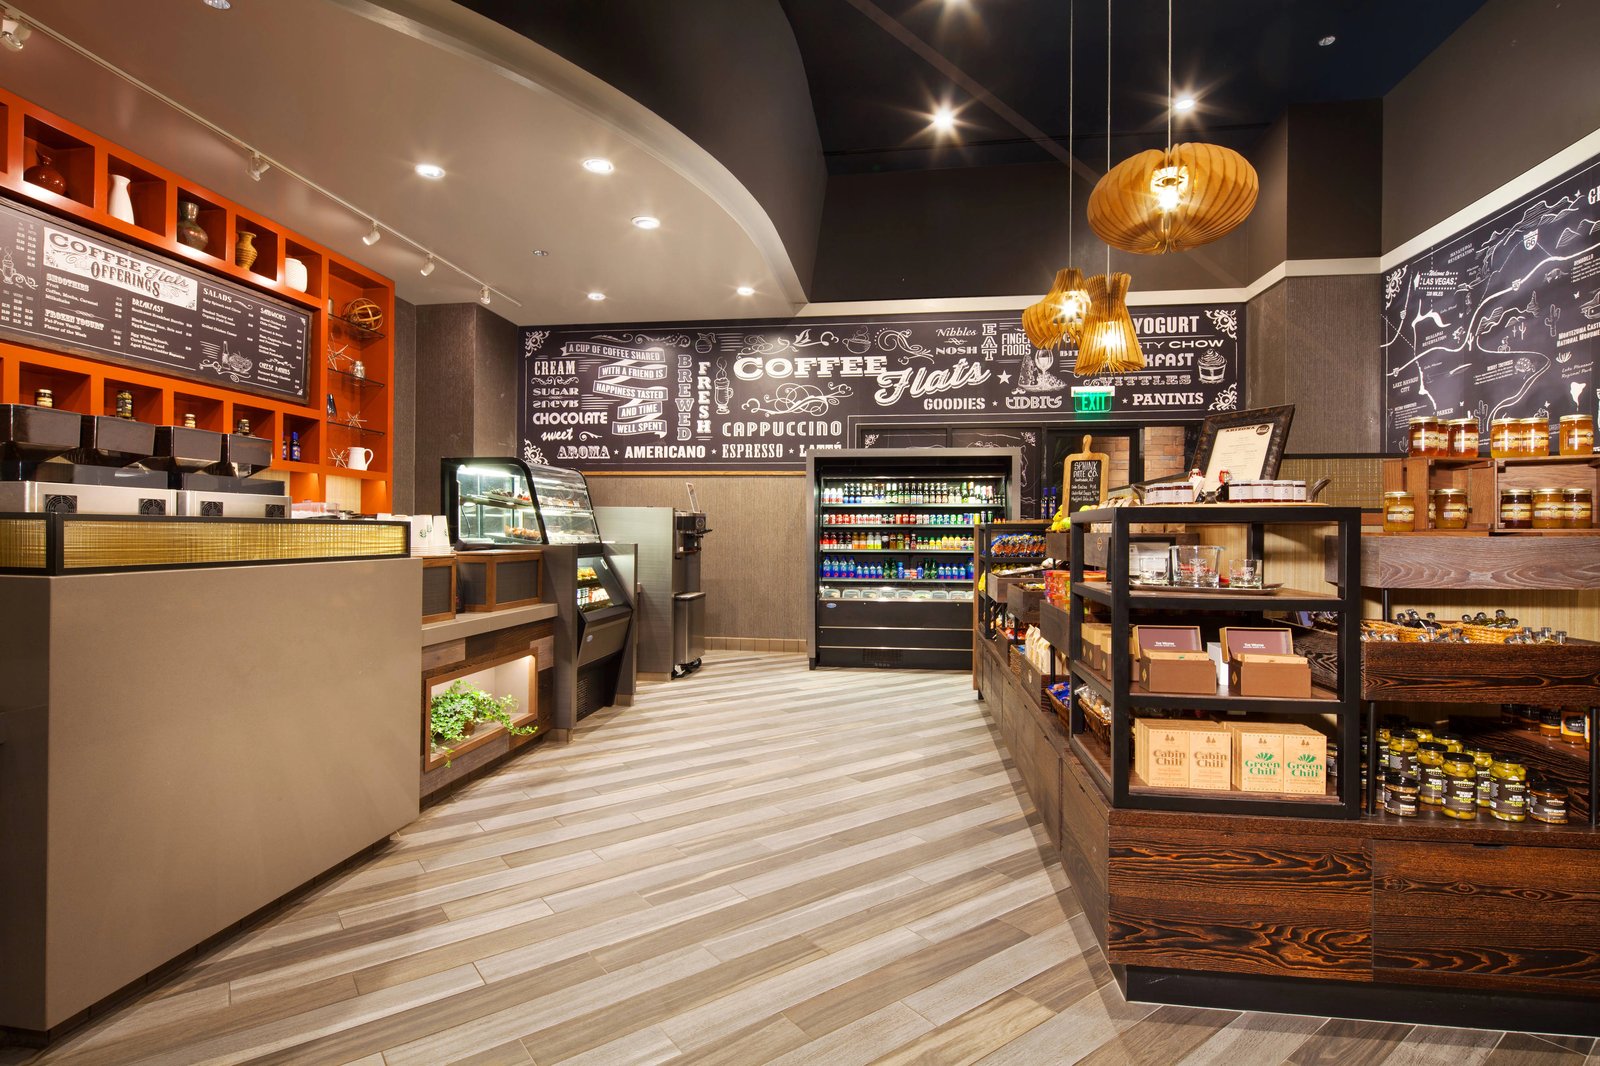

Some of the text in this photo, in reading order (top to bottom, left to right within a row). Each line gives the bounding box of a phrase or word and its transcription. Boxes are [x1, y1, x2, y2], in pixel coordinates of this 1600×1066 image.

[50, 233, 140, 272] COFFEE
[90, 261, 161, 298] OFFERINGS
[1422, 278, 1454, 286] LAS VEGAS
[203, 288, 232, 303] SALADS
[1133, 316, 1200, 334] YOGURT
[936, 327, 977, 337] Nibbles
[981, 323, 998, 361] EAT
[1169, 340, 1224, 348] CHOW
[575, 345, 590, 353] CUP
[592, 345, 600, 353] OF
[602, 347, 629, 359] COFFEE
[631, 351, 660, 361] SHARED
[936, 346, 978, 355] NOSH
[1002, 344, 1031, 356] FOODS
[534, 360, 576, 375] CREAM
[602, 367, 621, 375] WITH
[628, 368, 654, 378] FRIEND
[655, 369, 663, 377] IS
[733, 355, 992, 406] COFFEE Flats
[1100, 375, 1191, 386] VITTLES
[533, 388, 579, 396] SUGAR
[596, 382, 664, 399] HAPPINESS TASTED
[675, 354, 694, 441] BREWED
[697, 362, 712, 434] FRESH
[924, 398, 986, 410] GOODIES
[1132, 392, 1204, 406] PANINIS
[1082, 395, 1106, 410] EXIT
[621, 404, 658, 417] AND TIME
[532, 412, 608, 425] CHOCOLATE
[541, 427, 573, 441] sweet
[617, 422, 663, 433] WELL SPENT
[722, 421, 842, 437] CAPPUCCINO
[557, 444, 783, 459] AROMA AMERICANO ESPRESSO
[1153, 749, 1186, 759] Cabin
[1194, 751, 1227, 761] Cabin
[1155, 757, 1183, 766] Chili
[1196, 759, 1224, 768] Chili
[1244, 760, 1280, 768] Green
[1287, 762, 1323, 771] Green
[1249, 768, 1276, 776] Chili
[1291, 769, 1319, 777] Chili
